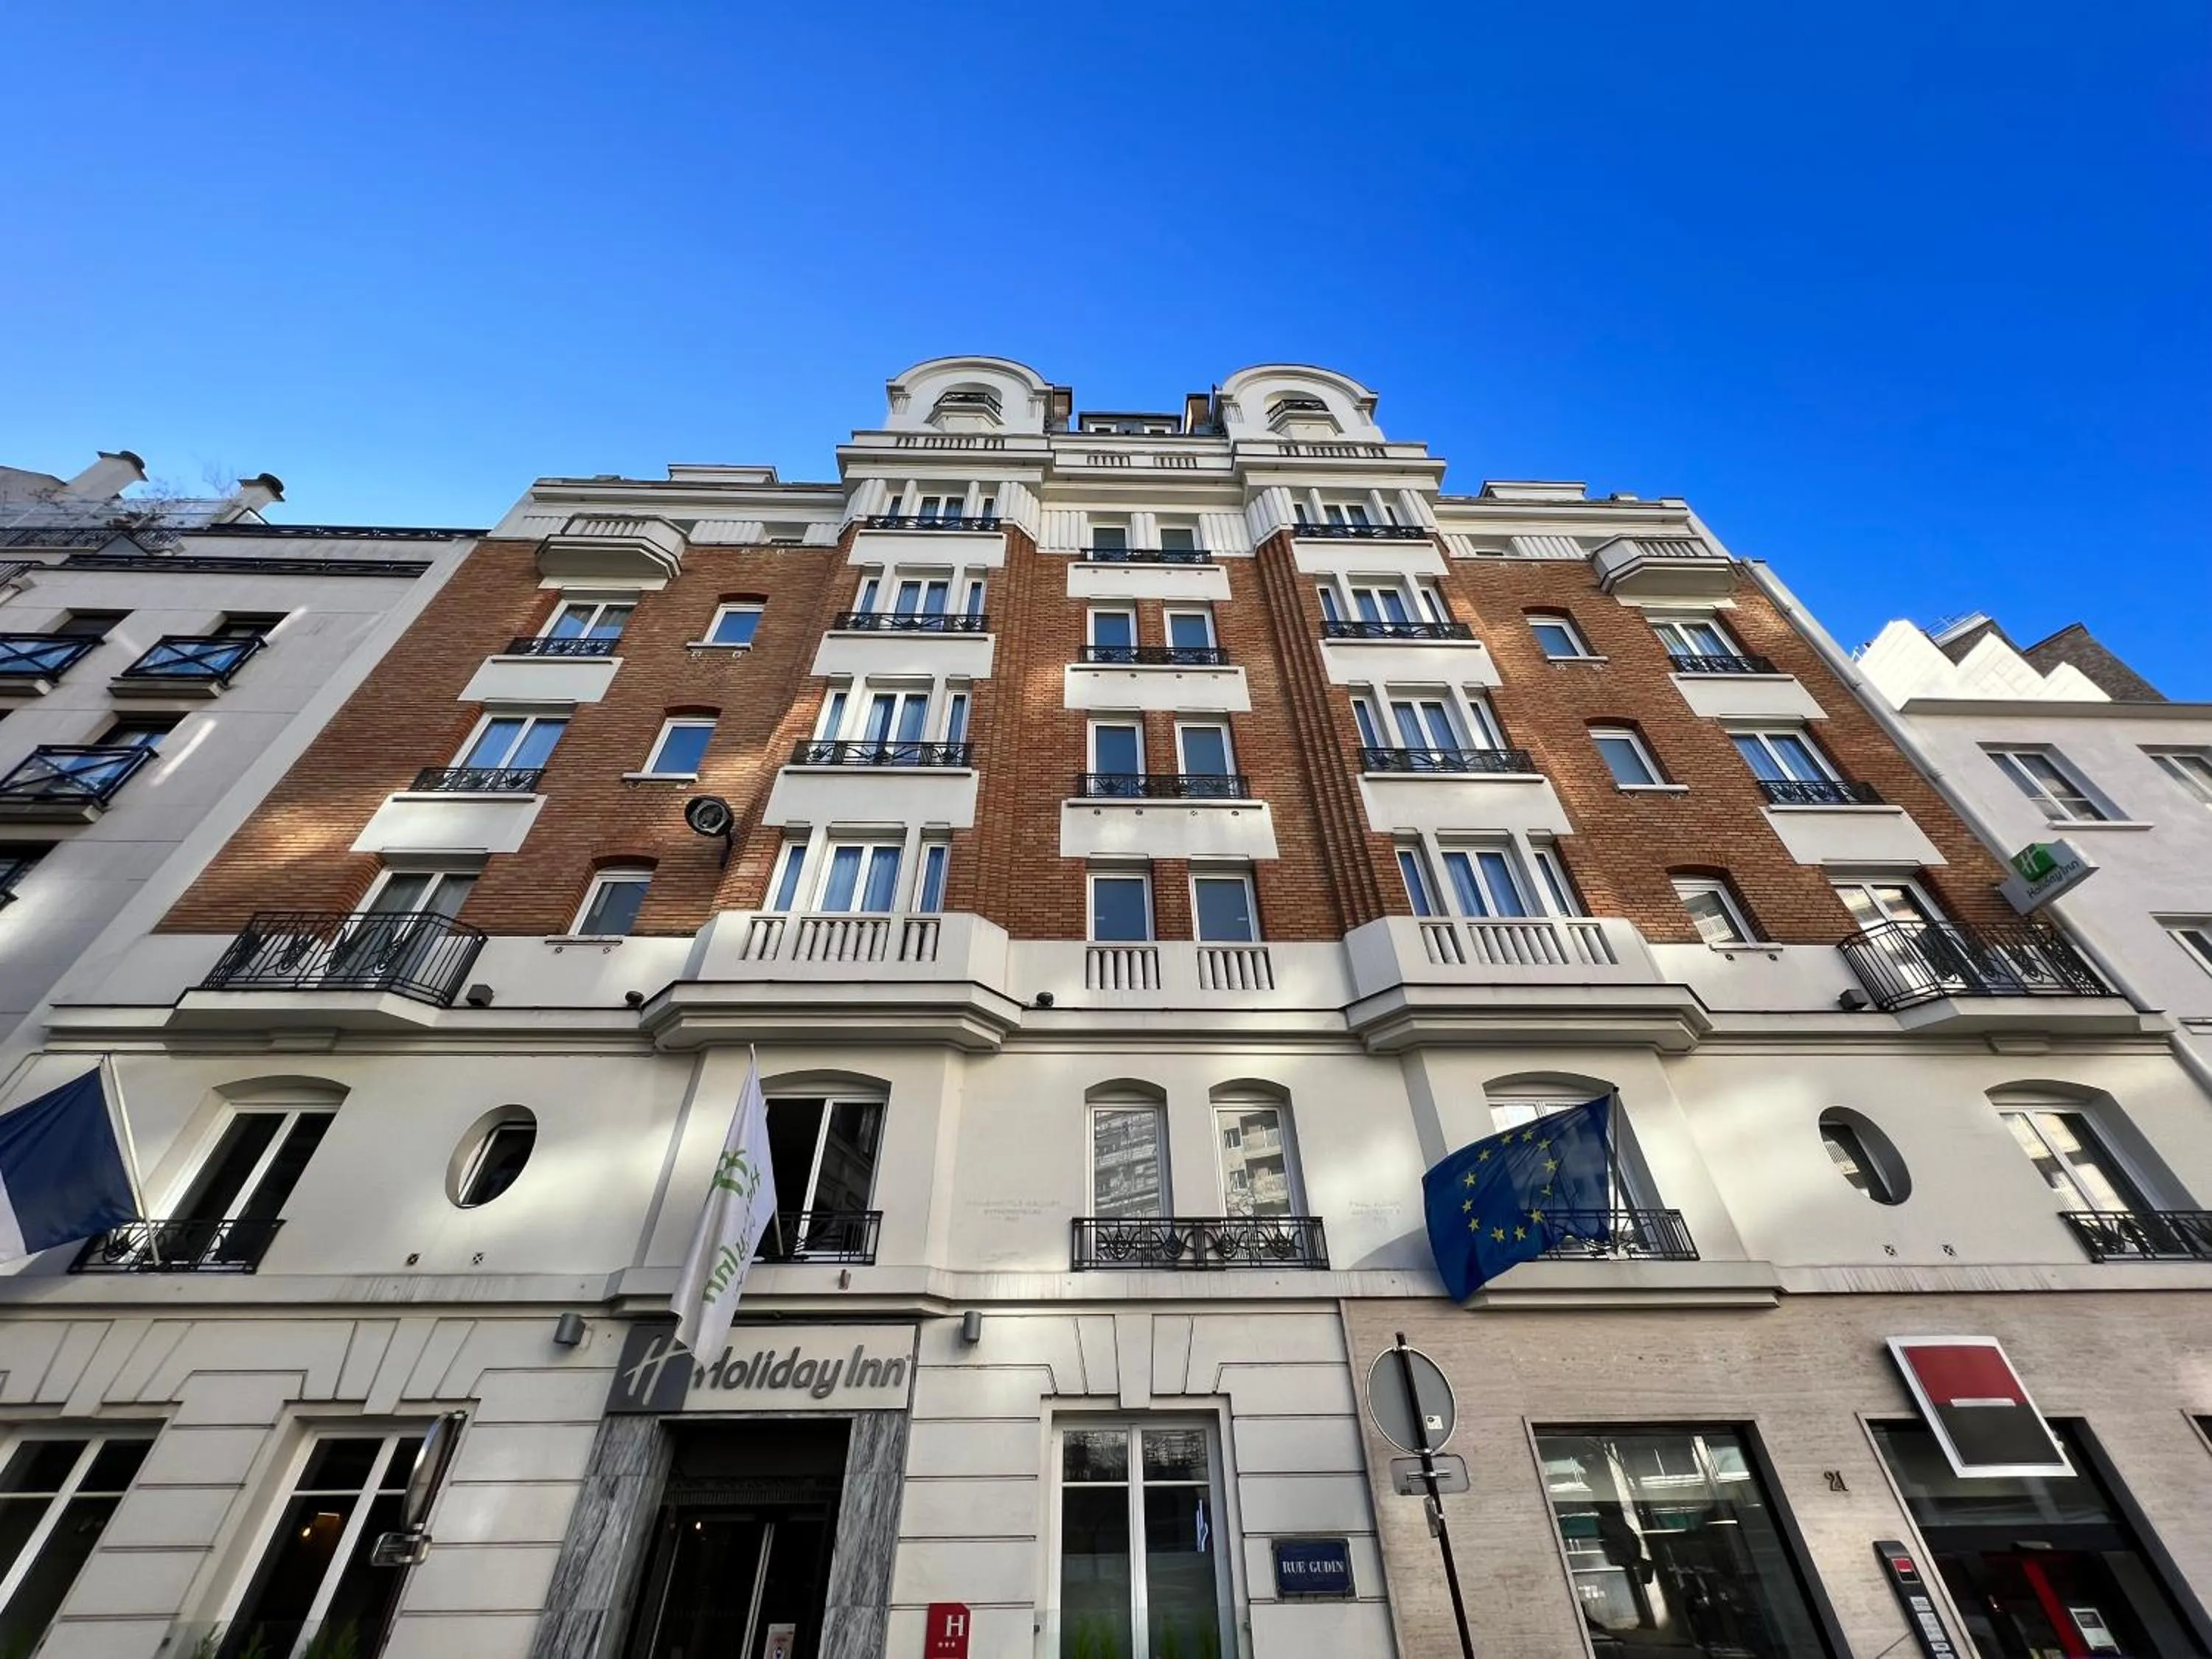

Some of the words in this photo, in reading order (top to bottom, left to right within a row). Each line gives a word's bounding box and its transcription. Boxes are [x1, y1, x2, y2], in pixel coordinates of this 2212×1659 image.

[844, 1344, 908, 1388] Inn
[1281, 1561, 1306, 1574] RUE
[1309, 1560, 1344, 1573] GUDIN
[945, 1614, 967, 1637] H
